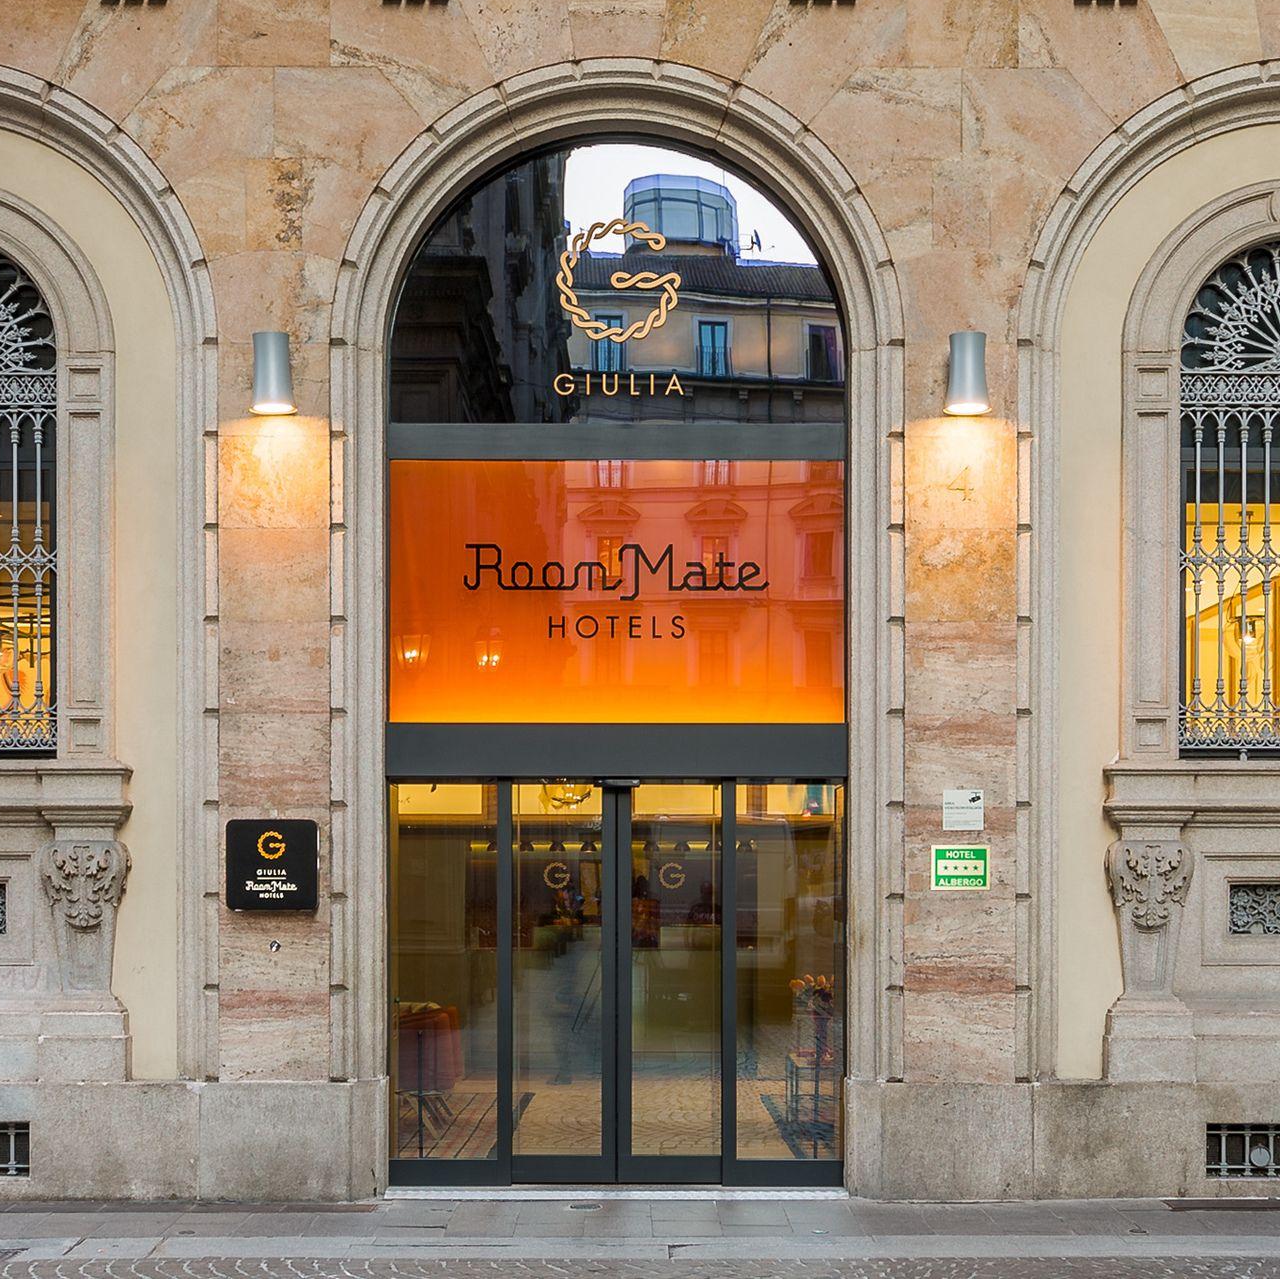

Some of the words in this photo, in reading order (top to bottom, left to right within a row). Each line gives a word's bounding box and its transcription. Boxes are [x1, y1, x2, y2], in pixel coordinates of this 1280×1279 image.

[552, 373, 685, 397] GIULIA
[548, 615, 686, 639] HOTELS
[946, 851, 976, 859] HOTEL
[938, 878, 983, 886] ALBERGO
